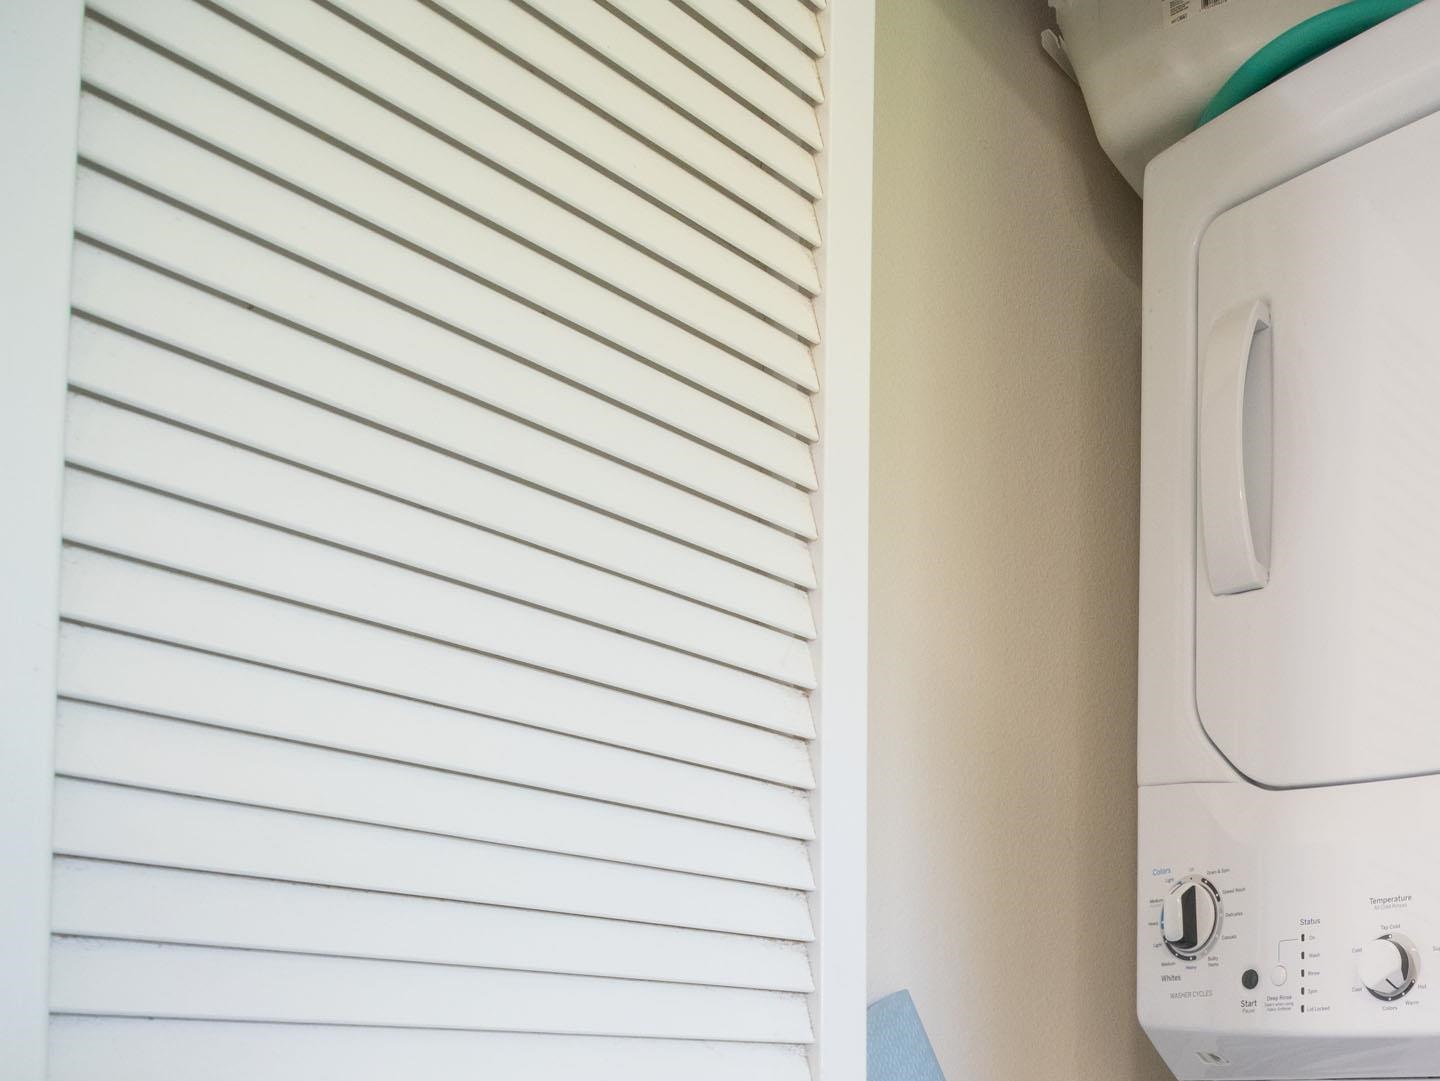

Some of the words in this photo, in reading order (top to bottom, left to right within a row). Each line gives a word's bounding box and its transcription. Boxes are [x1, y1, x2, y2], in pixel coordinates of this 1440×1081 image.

[1152, 867, 1171, 876] Colors
[1369, 895, 1412, 905] Temperature
[1299, 918, 1321, 926] Status
[1161, 975, 1181, 983] Whites
[1169, 991, 1192, 999] WASHER
[1192, 990, 1213, 998] CYCLES
[1240, 1000, 1257, 1008] Start
